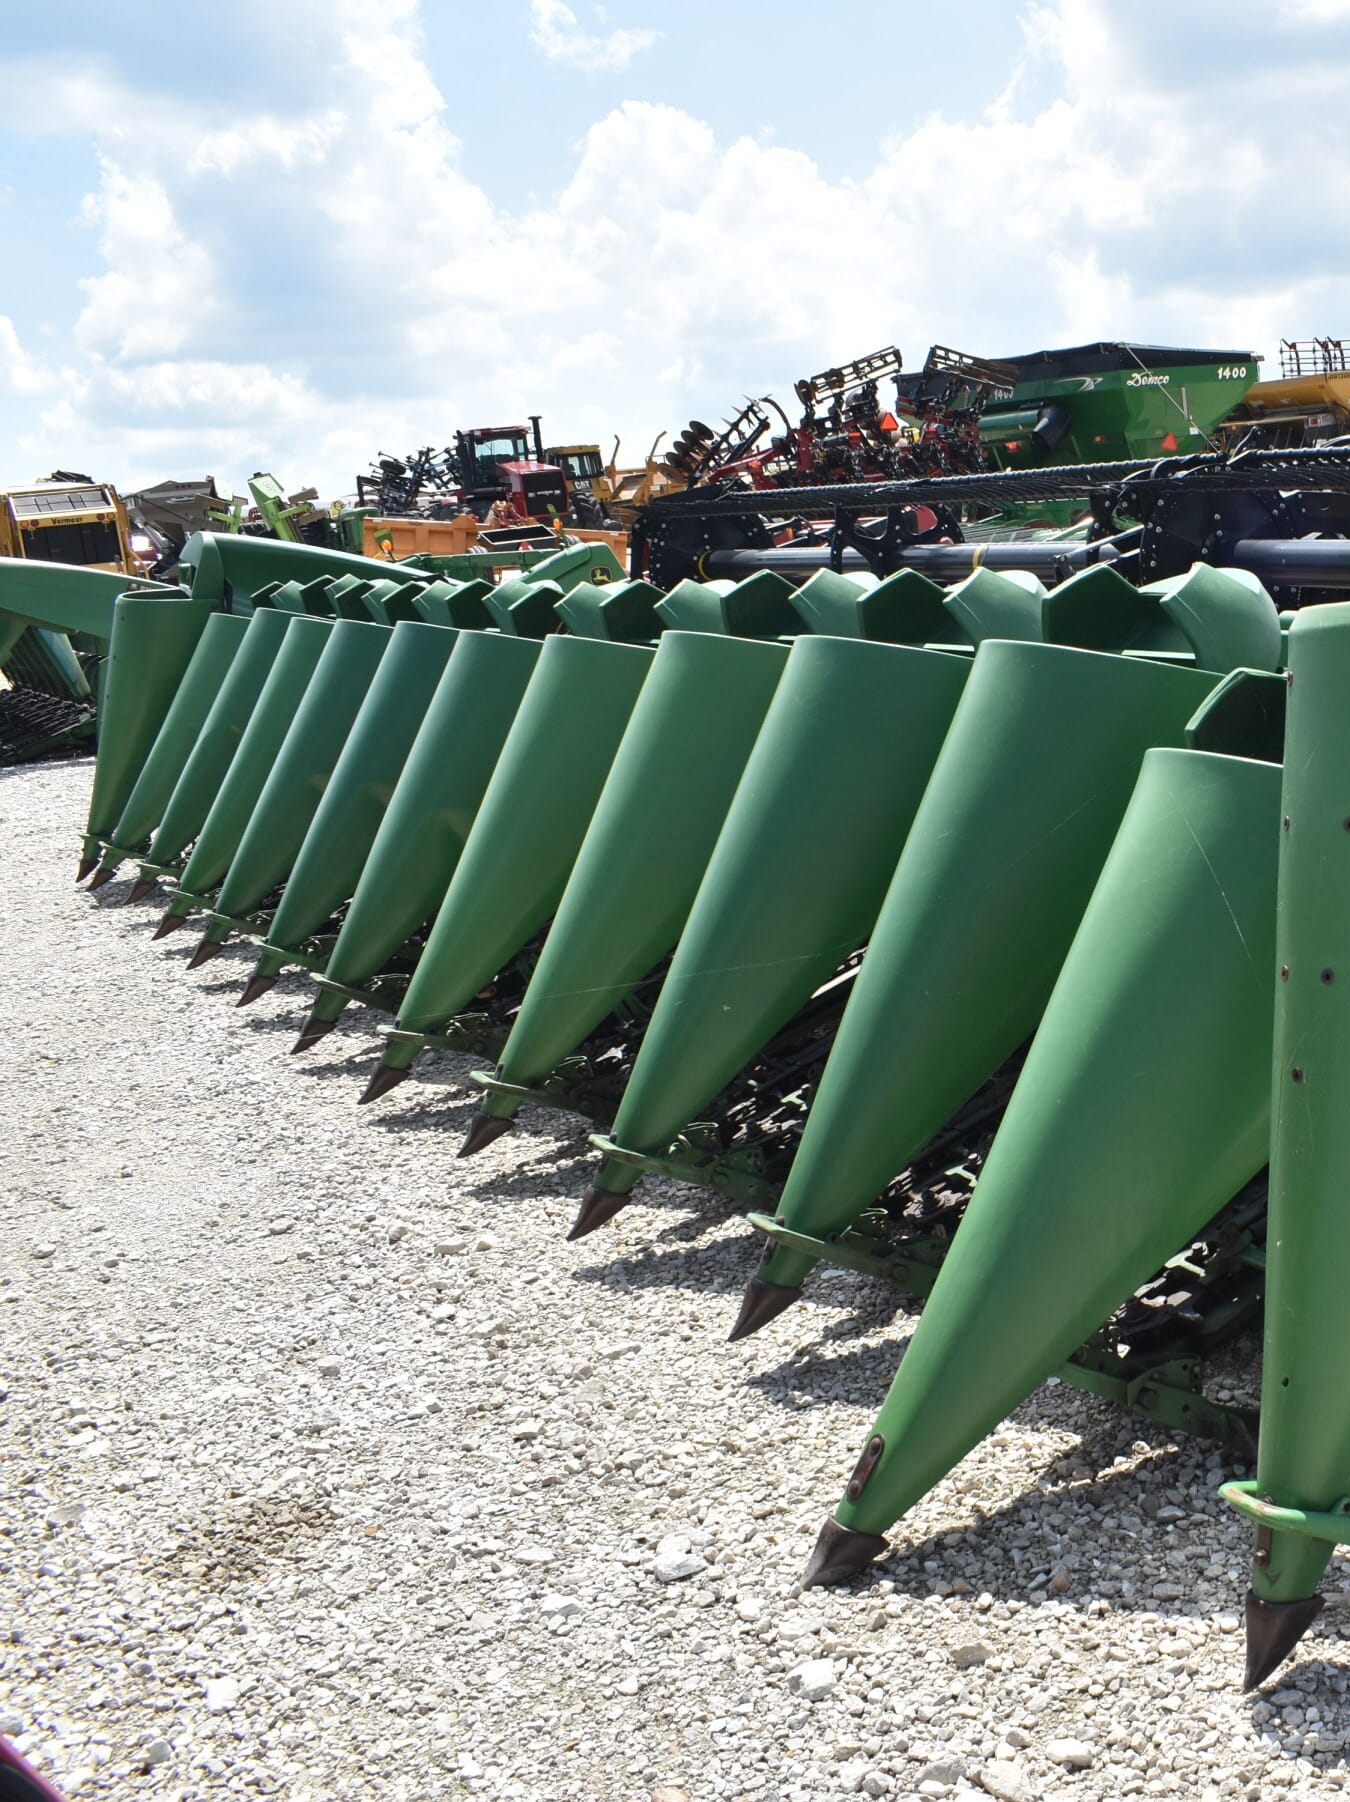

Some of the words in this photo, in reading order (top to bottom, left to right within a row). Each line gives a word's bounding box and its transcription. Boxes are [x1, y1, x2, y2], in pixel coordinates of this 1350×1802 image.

[1126, 371, 1170, 387] Demco
[1217, 366, 1247, 380] 1400
[574, 480, 591, 490] CAT
